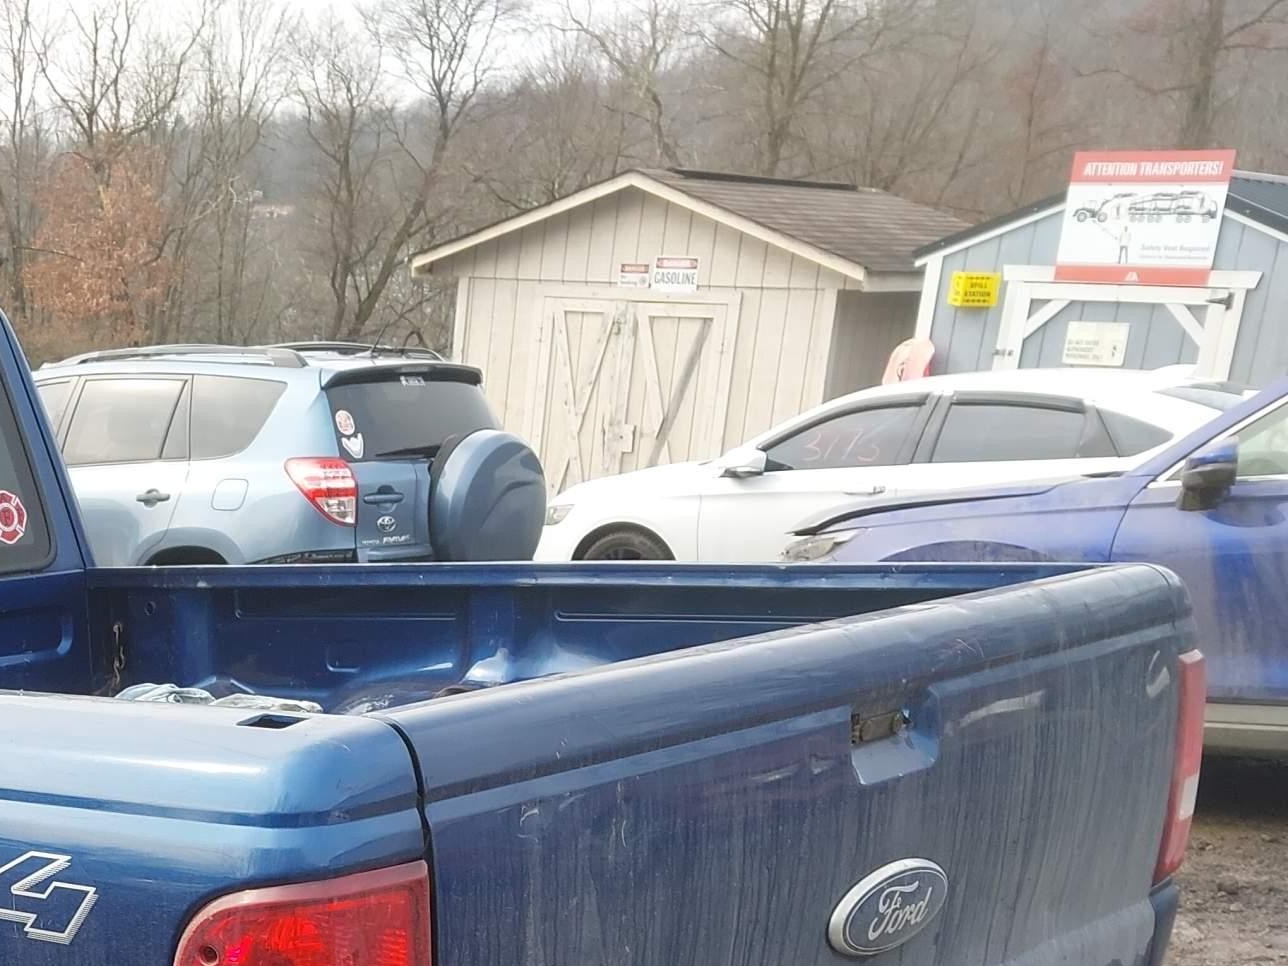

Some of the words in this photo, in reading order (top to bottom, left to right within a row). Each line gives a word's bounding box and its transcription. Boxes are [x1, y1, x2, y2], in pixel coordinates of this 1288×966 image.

[1083, 161, 1138, 177] ATTENTION
[1139, 160, 1225, 176] TRANSPORTERS!
[654, 271, 697, 285] GASOLINE
[868, 880, 933, 941] Ford
